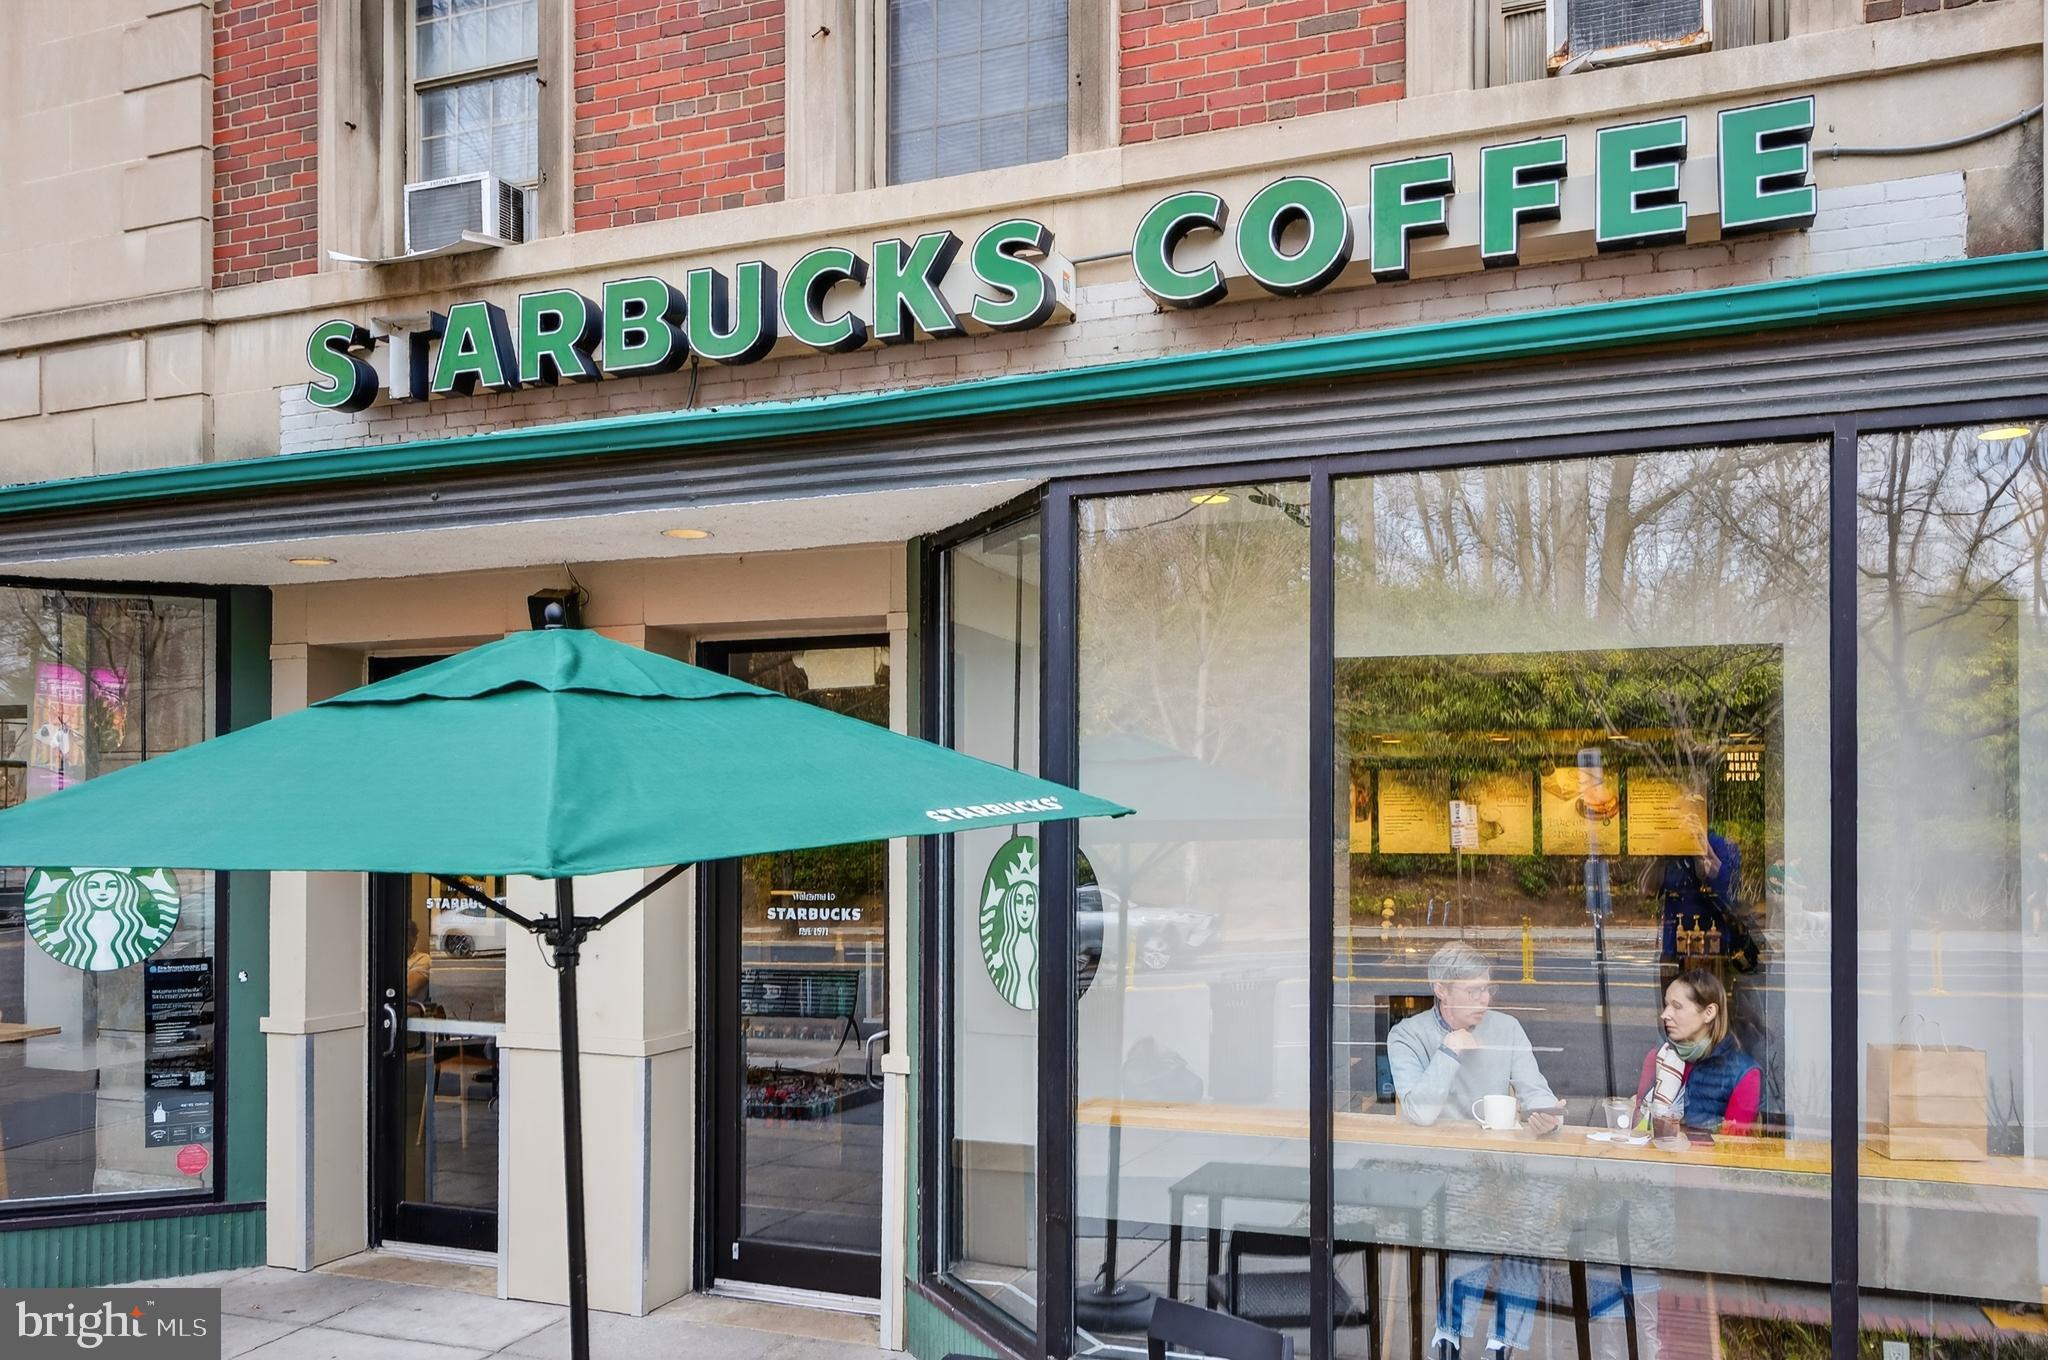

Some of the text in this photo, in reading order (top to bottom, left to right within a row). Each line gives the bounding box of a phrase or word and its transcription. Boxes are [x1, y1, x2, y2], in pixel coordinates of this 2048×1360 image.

[305, 96, 1818, 412] STARBUCKS COFFEE
[925, 796, 1064, 822] STARBUCKS
[767, 907, 861, 921] STARBUCKS
